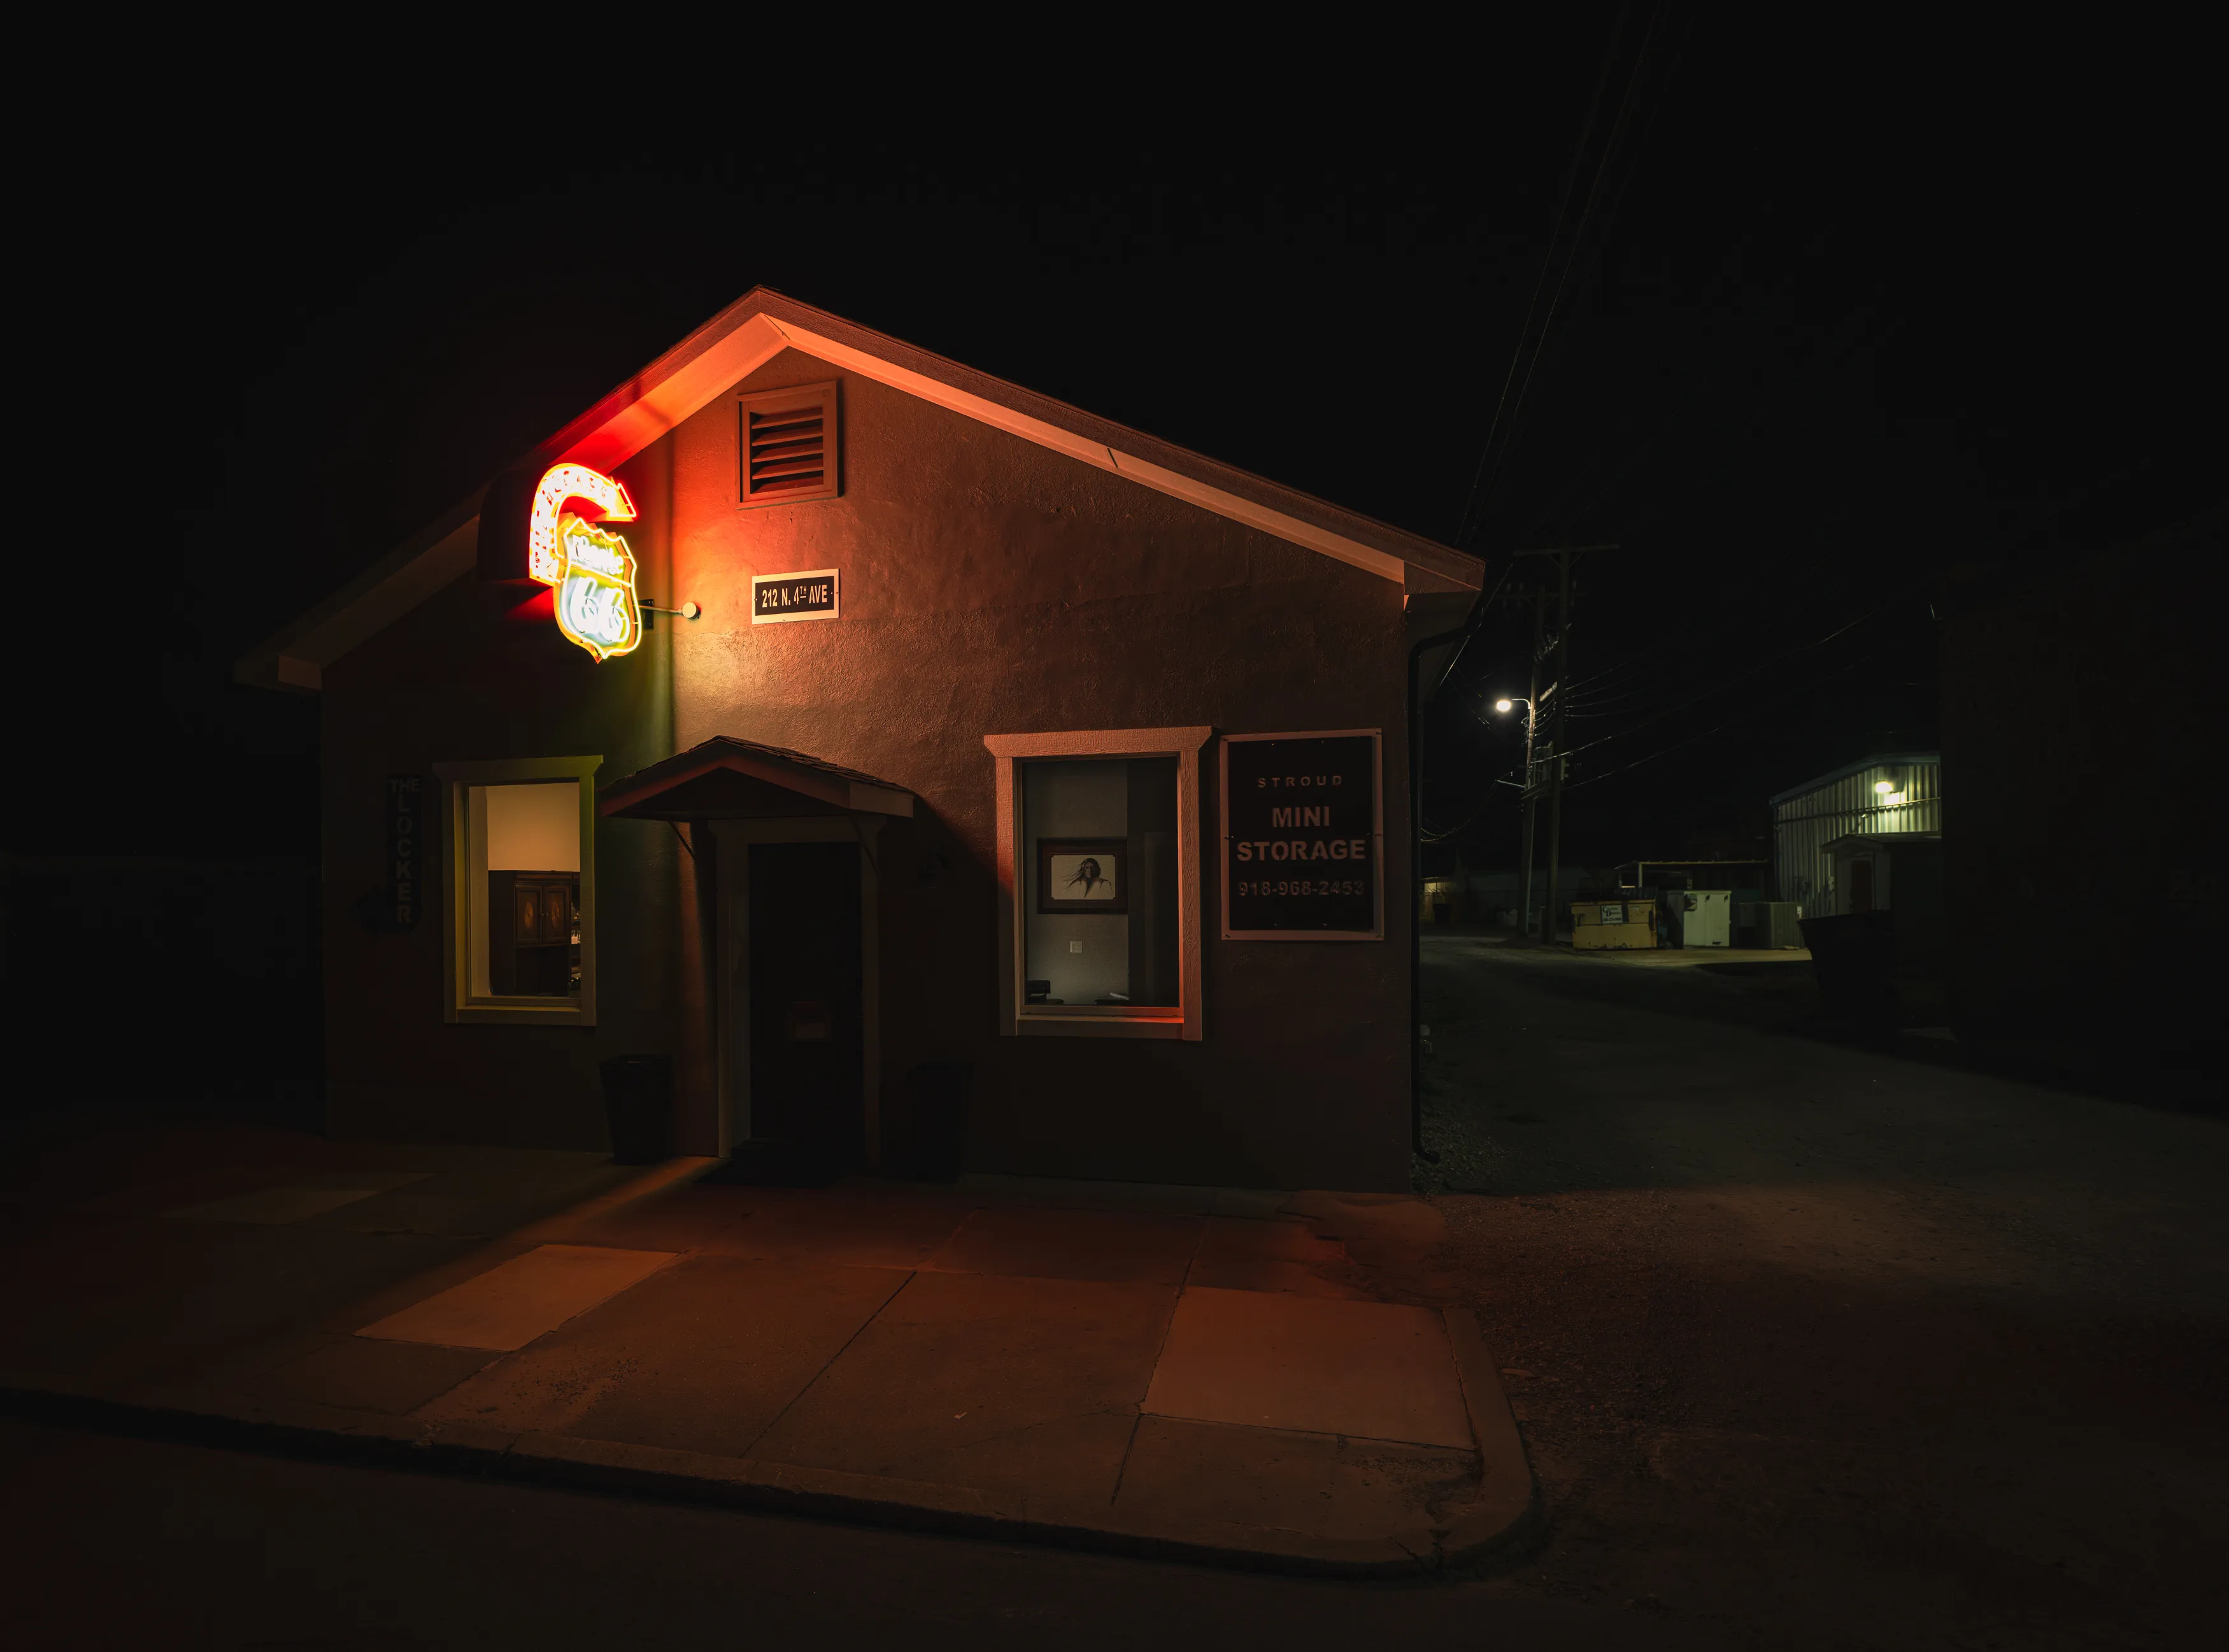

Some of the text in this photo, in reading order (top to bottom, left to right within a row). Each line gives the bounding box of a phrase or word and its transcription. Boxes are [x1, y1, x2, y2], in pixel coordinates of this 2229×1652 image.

[762, 588, 778, 608] 212
[781, 588, 791, 606] N.
[808, 584, 828, 604] AVE
[571, 576, 630, 643] 66
[389, 778, 422, 794] THE
[1257, 775, 1342, 788] STROUD
[1272, 806, 1331, 828] MINI
[395, 793, 413, 924] LOCKER
[1236, 839, 1367, 862] STORAGE
[1237, 880, 1365, 896] 918-968-2453
